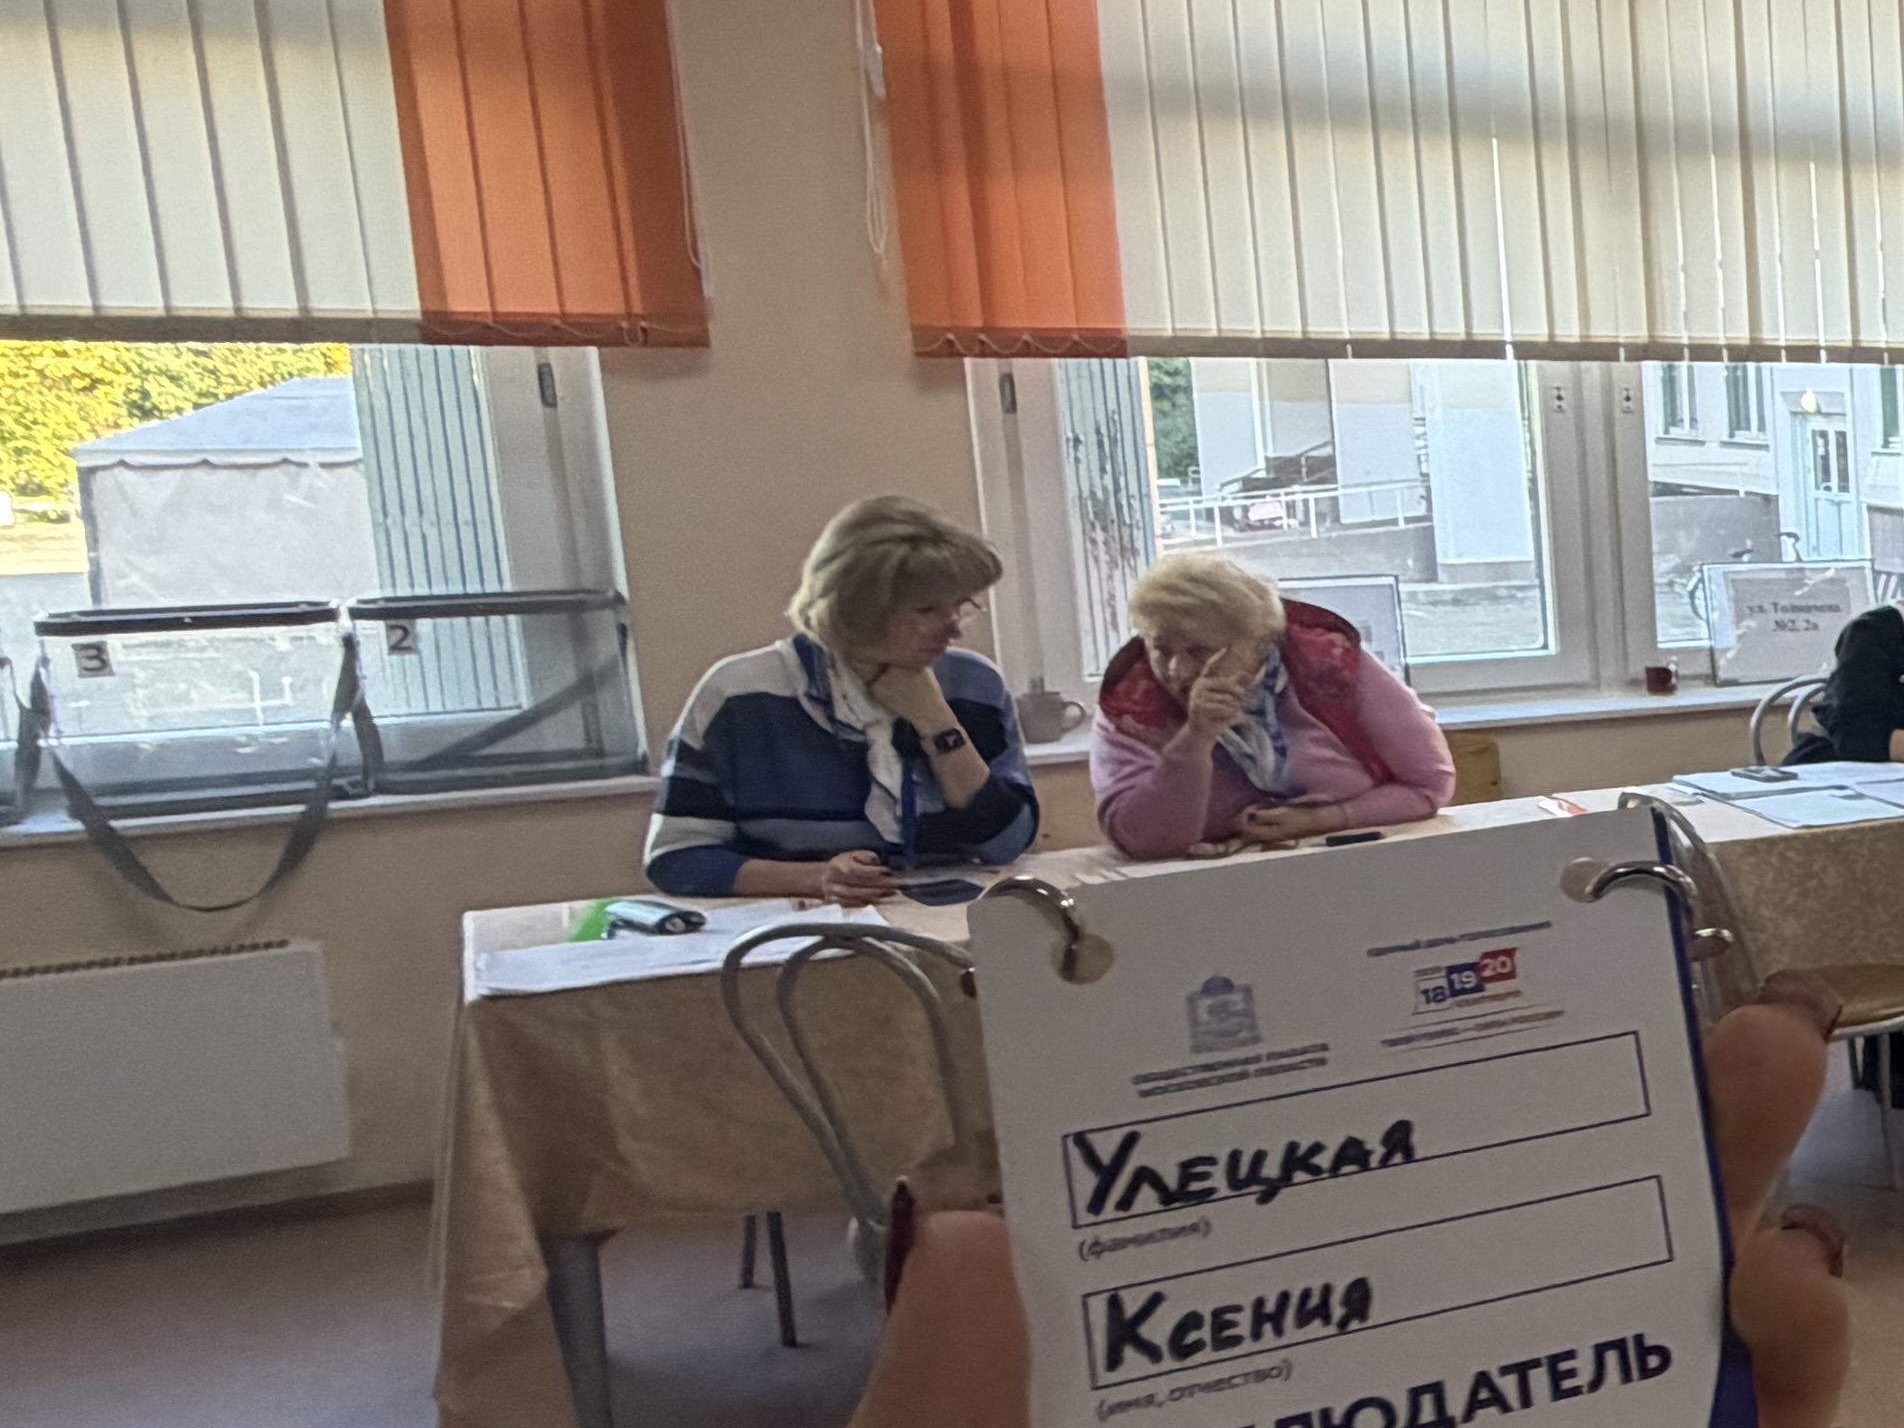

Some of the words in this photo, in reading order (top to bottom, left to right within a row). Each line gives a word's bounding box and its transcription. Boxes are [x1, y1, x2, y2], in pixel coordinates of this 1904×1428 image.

[388, 625, 412, 653] 2
[80, 643, 108, 673] 3
[1421, 984, 1449, 1005] 18
[1450, 970, 1477, 990] 19
[1479, 955, 1512, 977] 20
